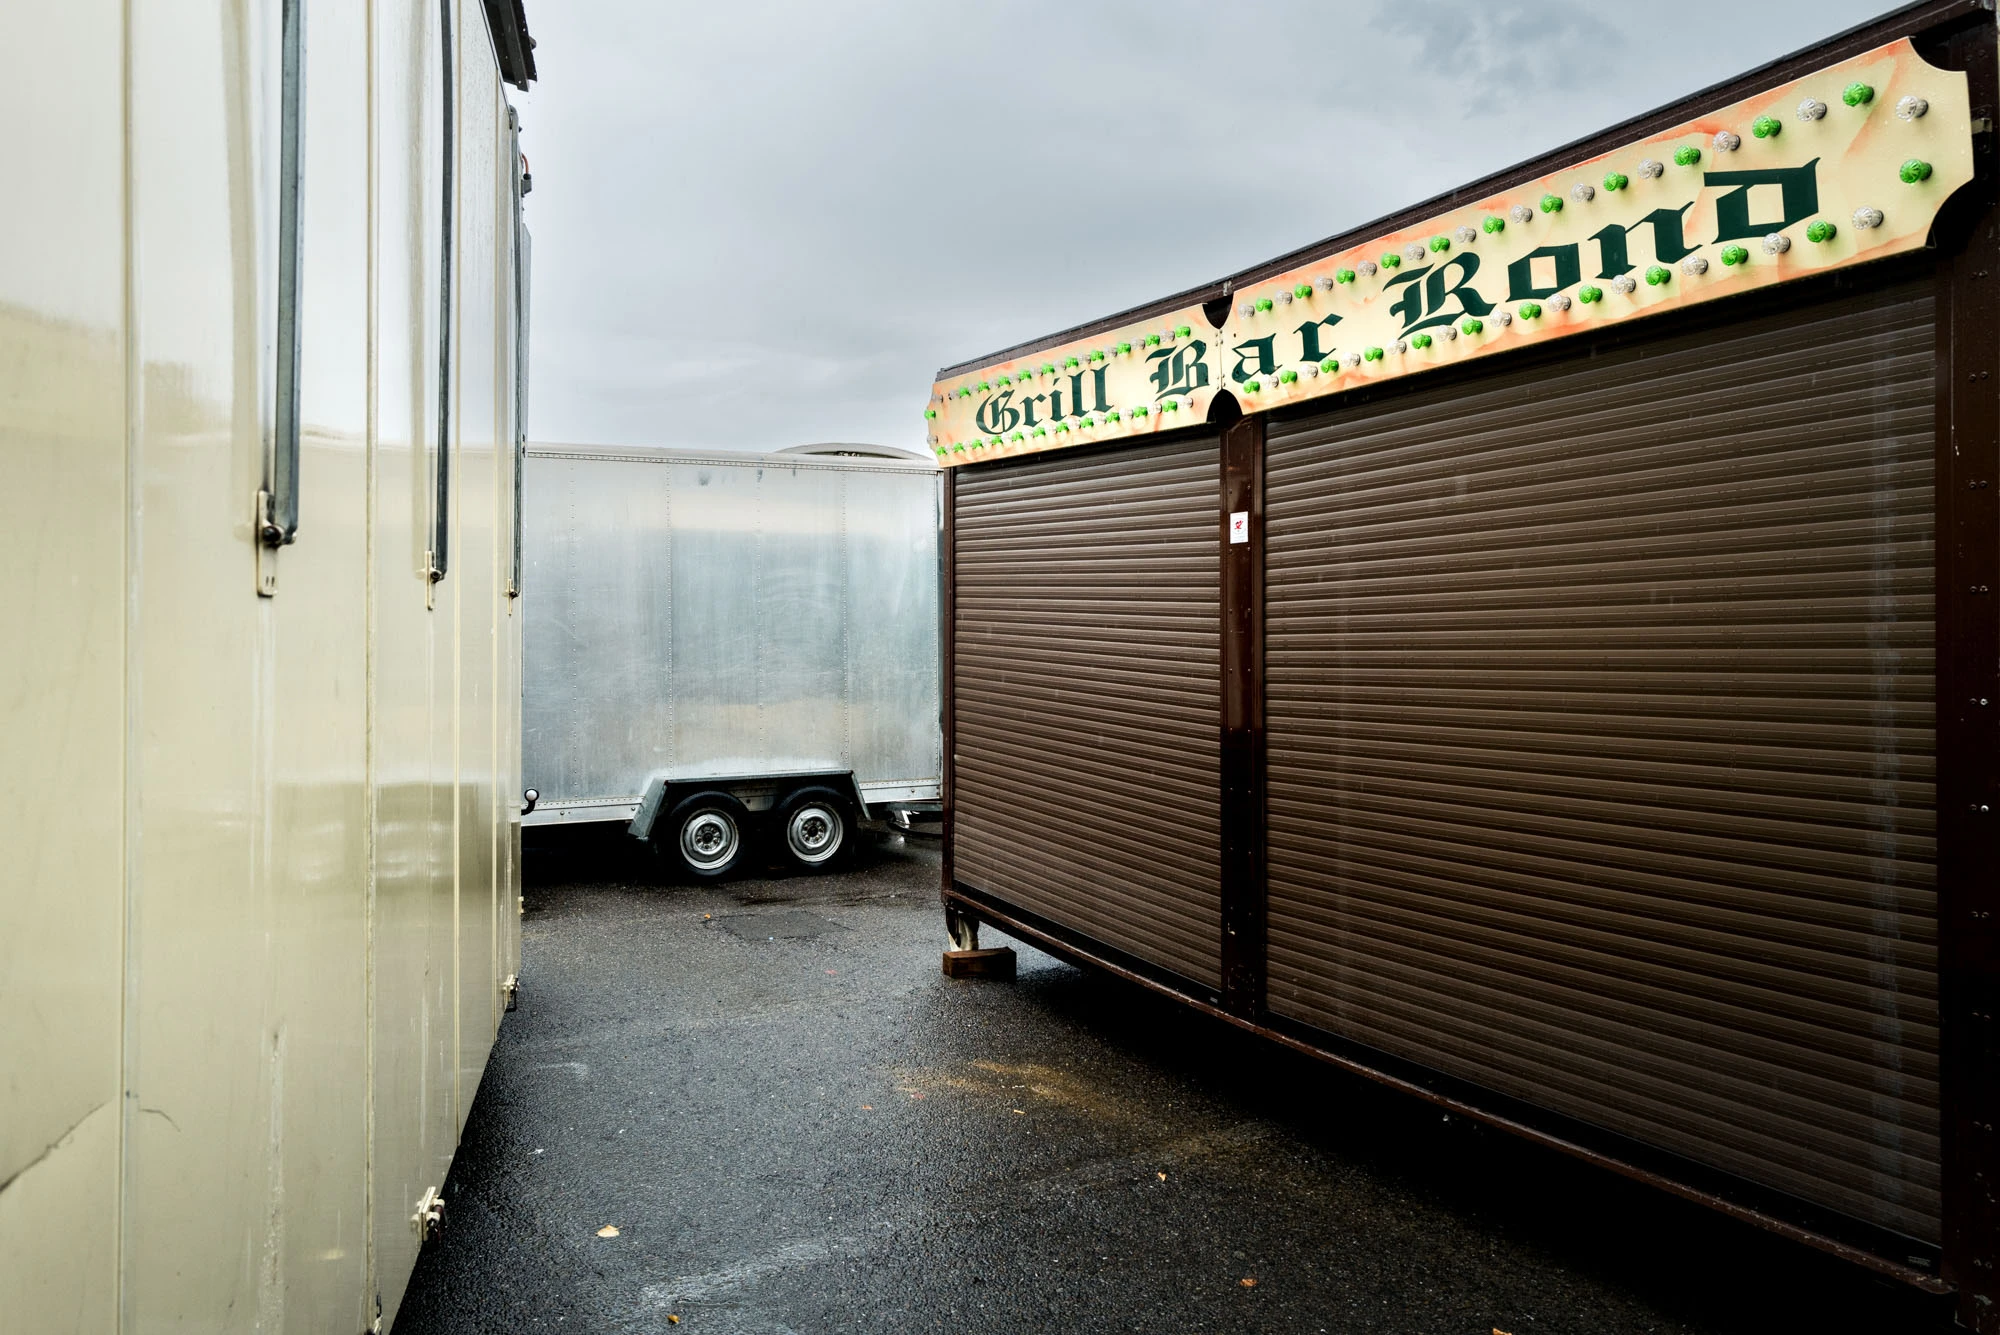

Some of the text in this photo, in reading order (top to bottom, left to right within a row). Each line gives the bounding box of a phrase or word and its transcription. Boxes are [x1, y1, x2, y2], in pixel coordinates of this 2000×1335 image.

[976, 157, 1821, 436] Grill Bar Rond
